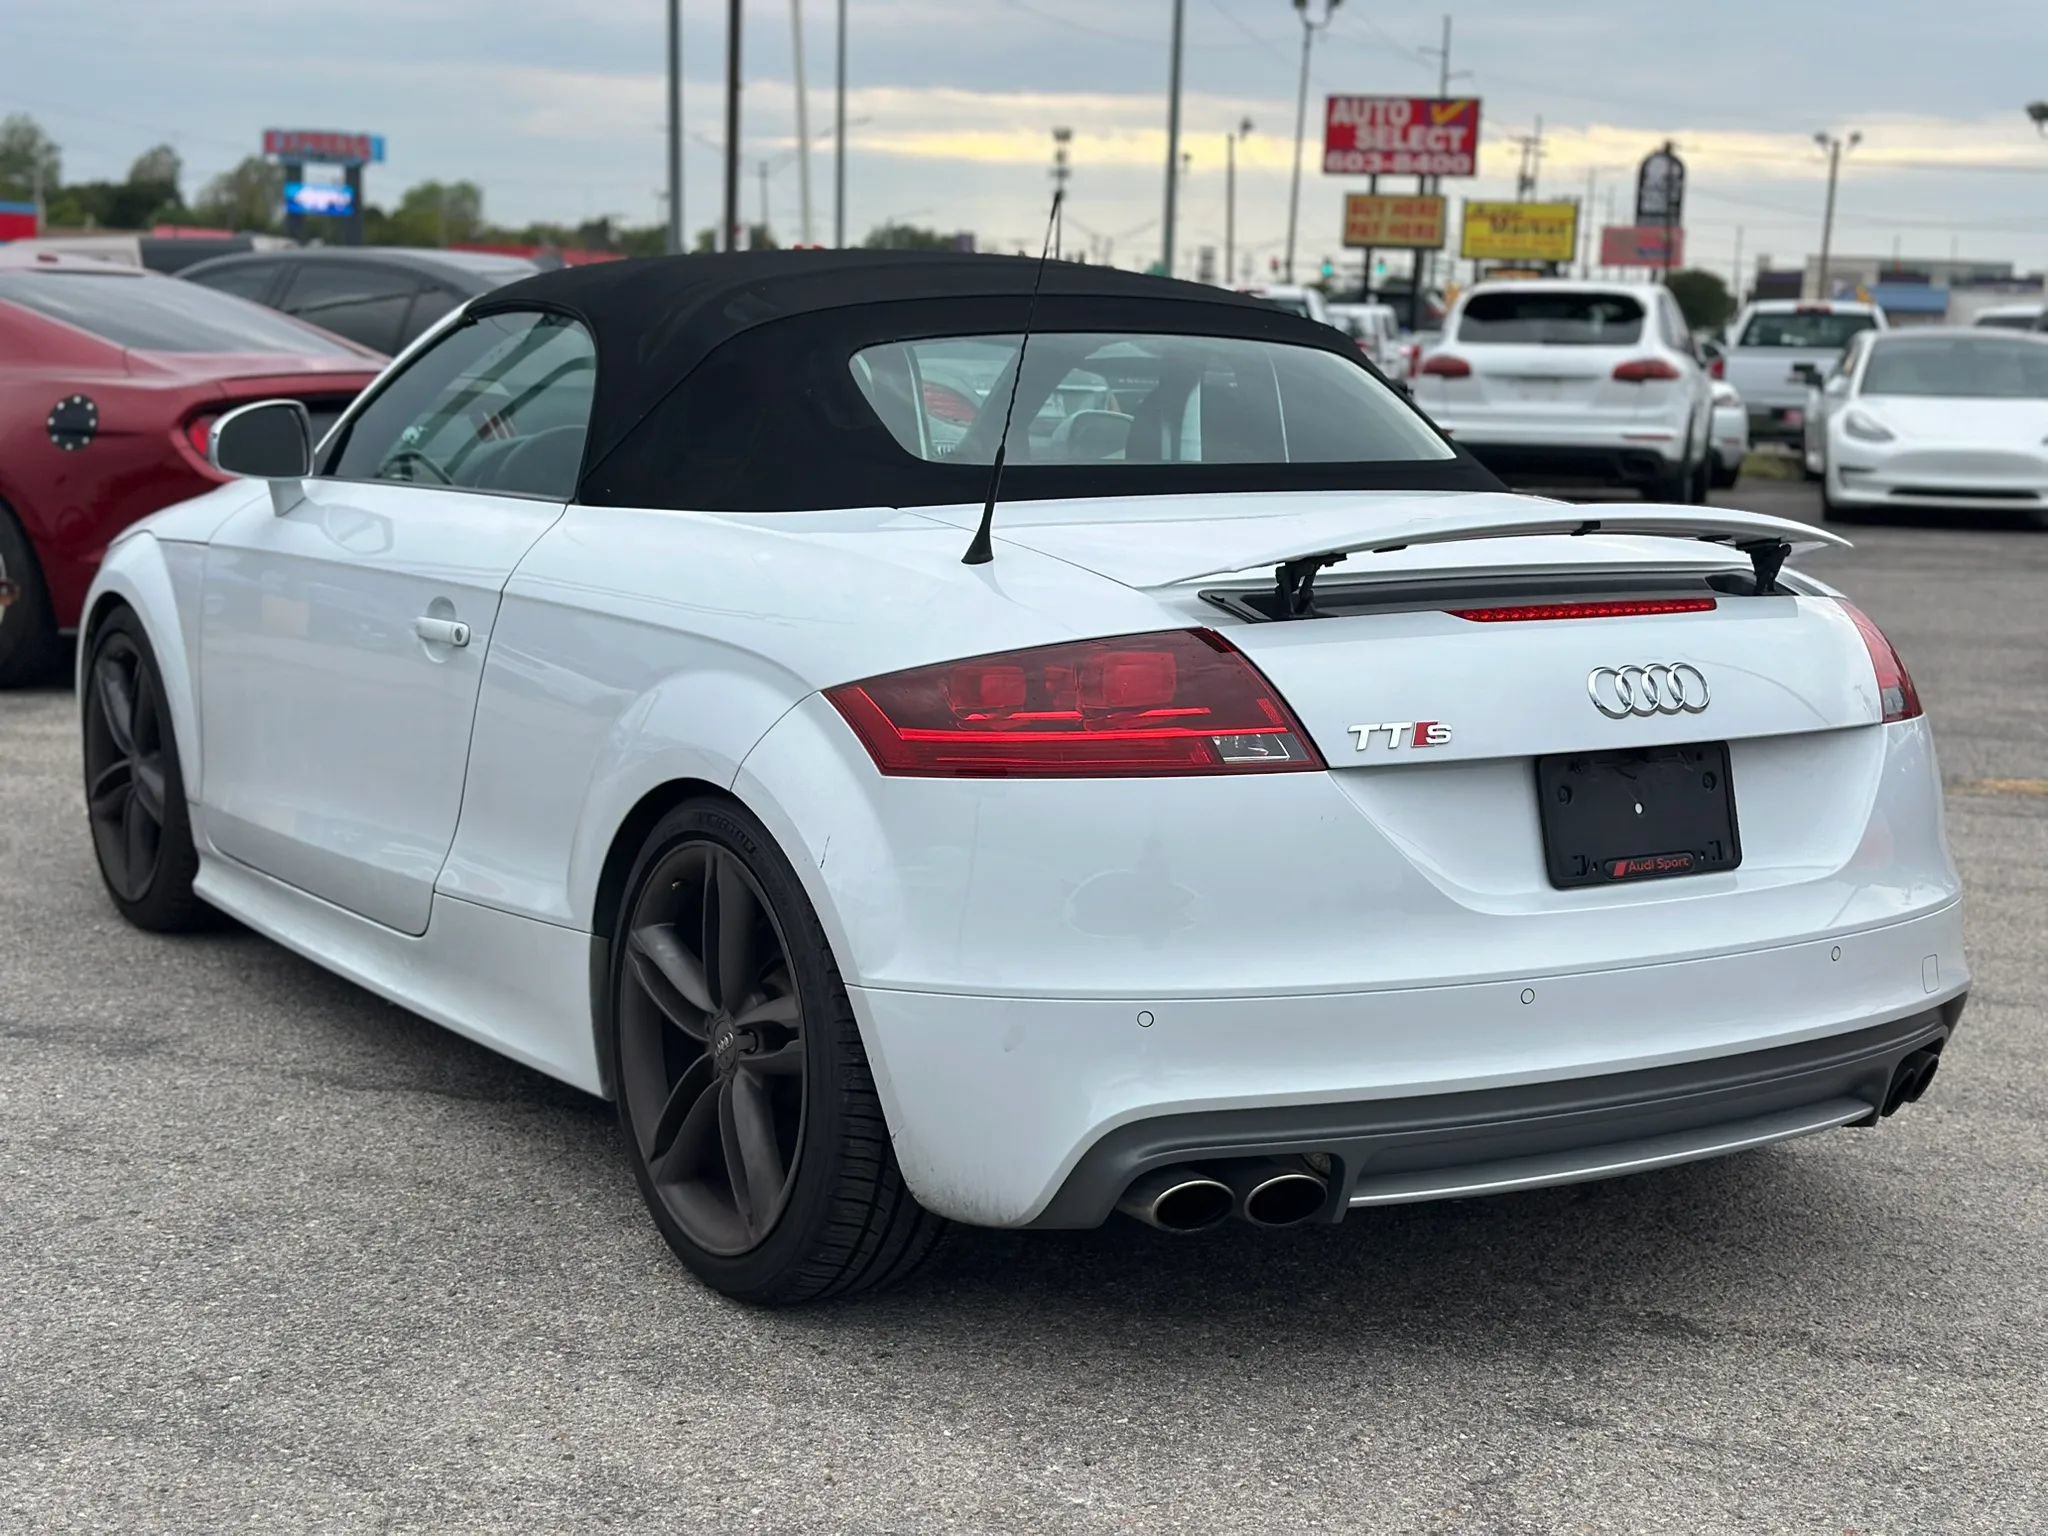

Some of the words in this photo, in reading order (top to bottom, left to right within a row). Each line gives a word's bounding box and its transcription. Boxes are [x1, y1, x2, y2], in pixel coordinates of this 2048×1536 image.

[1331, 99, 1412, 125] AUTO
[1354, 125, 1468, 151] SELECT
[1347, 720, 1452, 751] TTS
[1628, 859, 1655, 873] Audi
[1657, 857, 1689, 870] Sport
